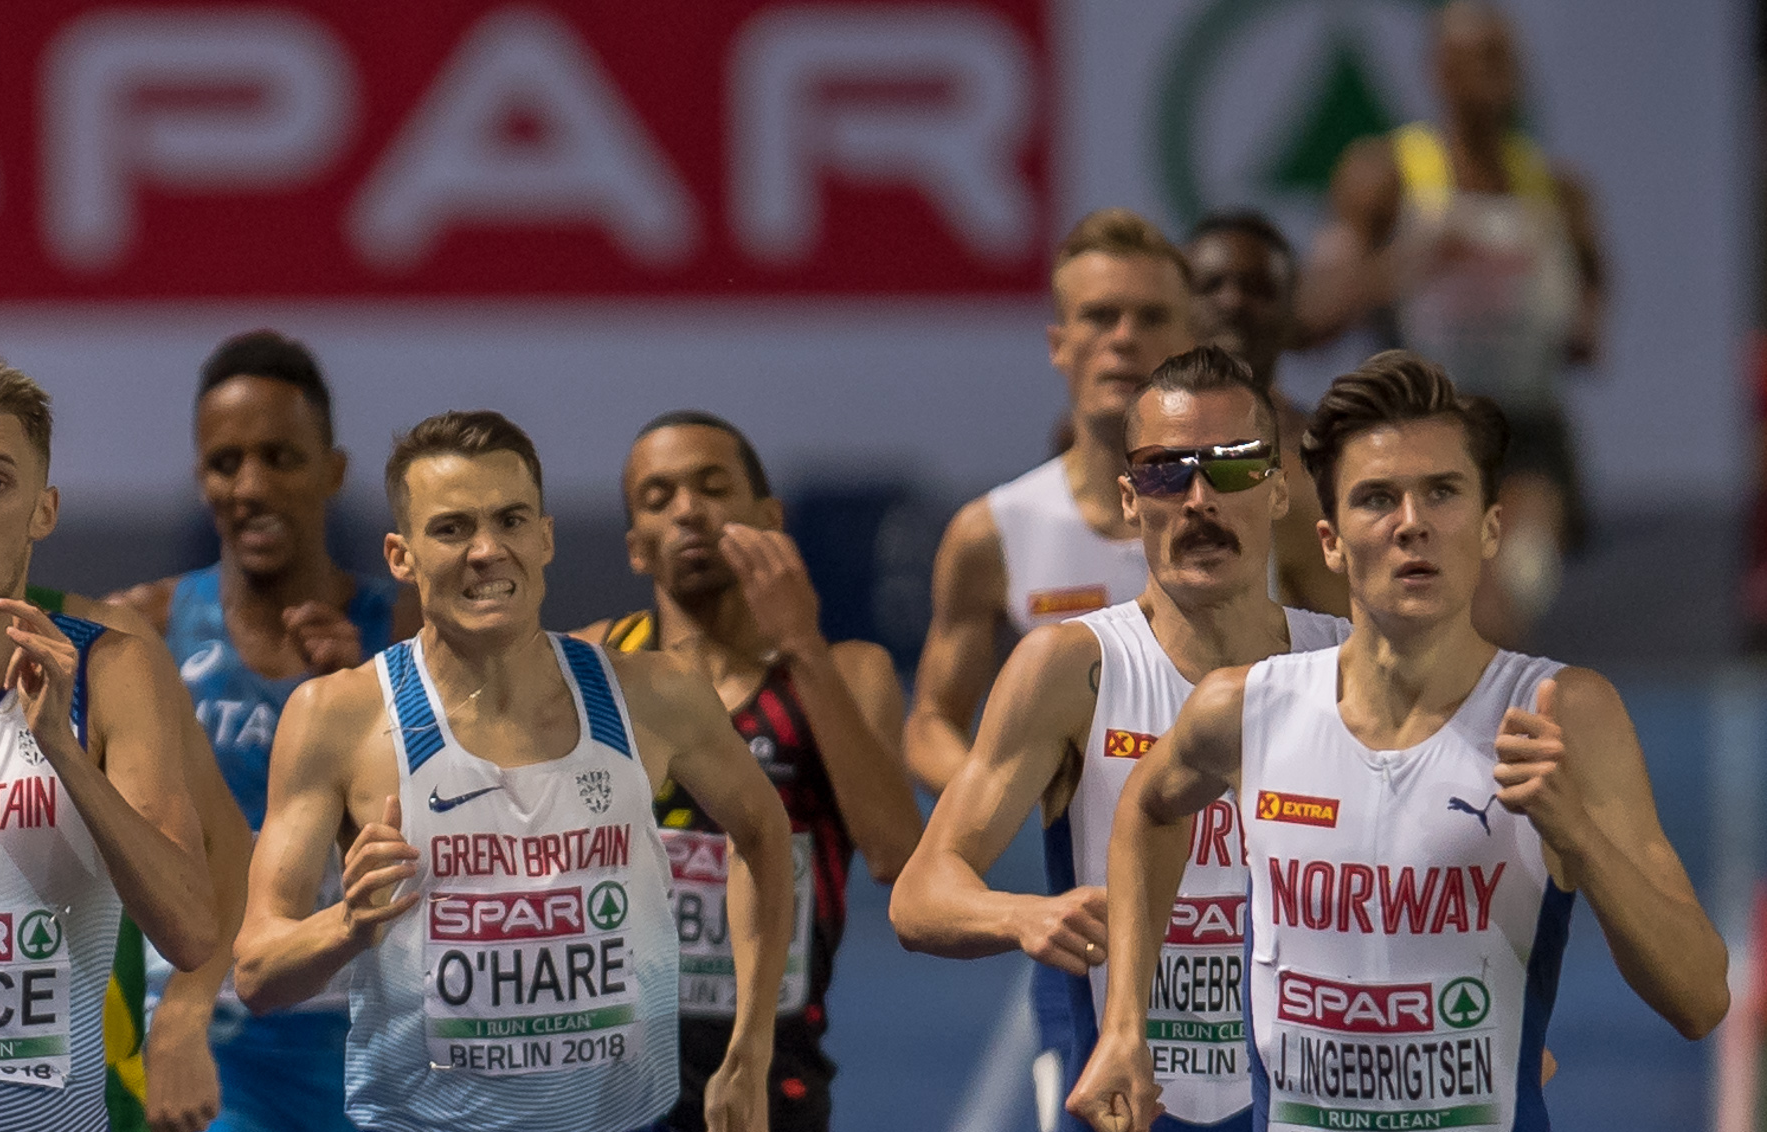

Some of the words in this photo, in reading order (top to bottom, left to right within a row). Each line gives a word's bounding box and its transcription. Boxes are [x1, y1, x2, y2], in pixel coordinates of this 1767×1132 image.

[1282, 801, 1334, 820] EXTRA
[430, 832, 518, 878] GREAT
[521, 822, 631, 878] BRITAIN
[434, 894, 581, 935] SPAR
[1268, 856, 1508, 935] NORWAY
[436, 936, 626, 1006] O'HARE
[1282, 977, 1429, 1027] SPAR
[476, 1021, 481, 1036] I
[487, 1020, 526, 1036] RUN
[1161, 1022, 1166, 1037] I
[1172, 1024, 1212, 1039] RUN
[449, 1041, 552, 1071] BERLIN
[561, 1032, 626, 1065] 2018
[1153, 1046, 1236, 1075] ERLIN
[1274, 1032, 1293, 1091] J.
[1300, 1036, 1493, 1101] INGEBRIGTSEN
[1319, 1111, 1324, 1125] I
[1328, 1111, 1370, 1128] RUN
